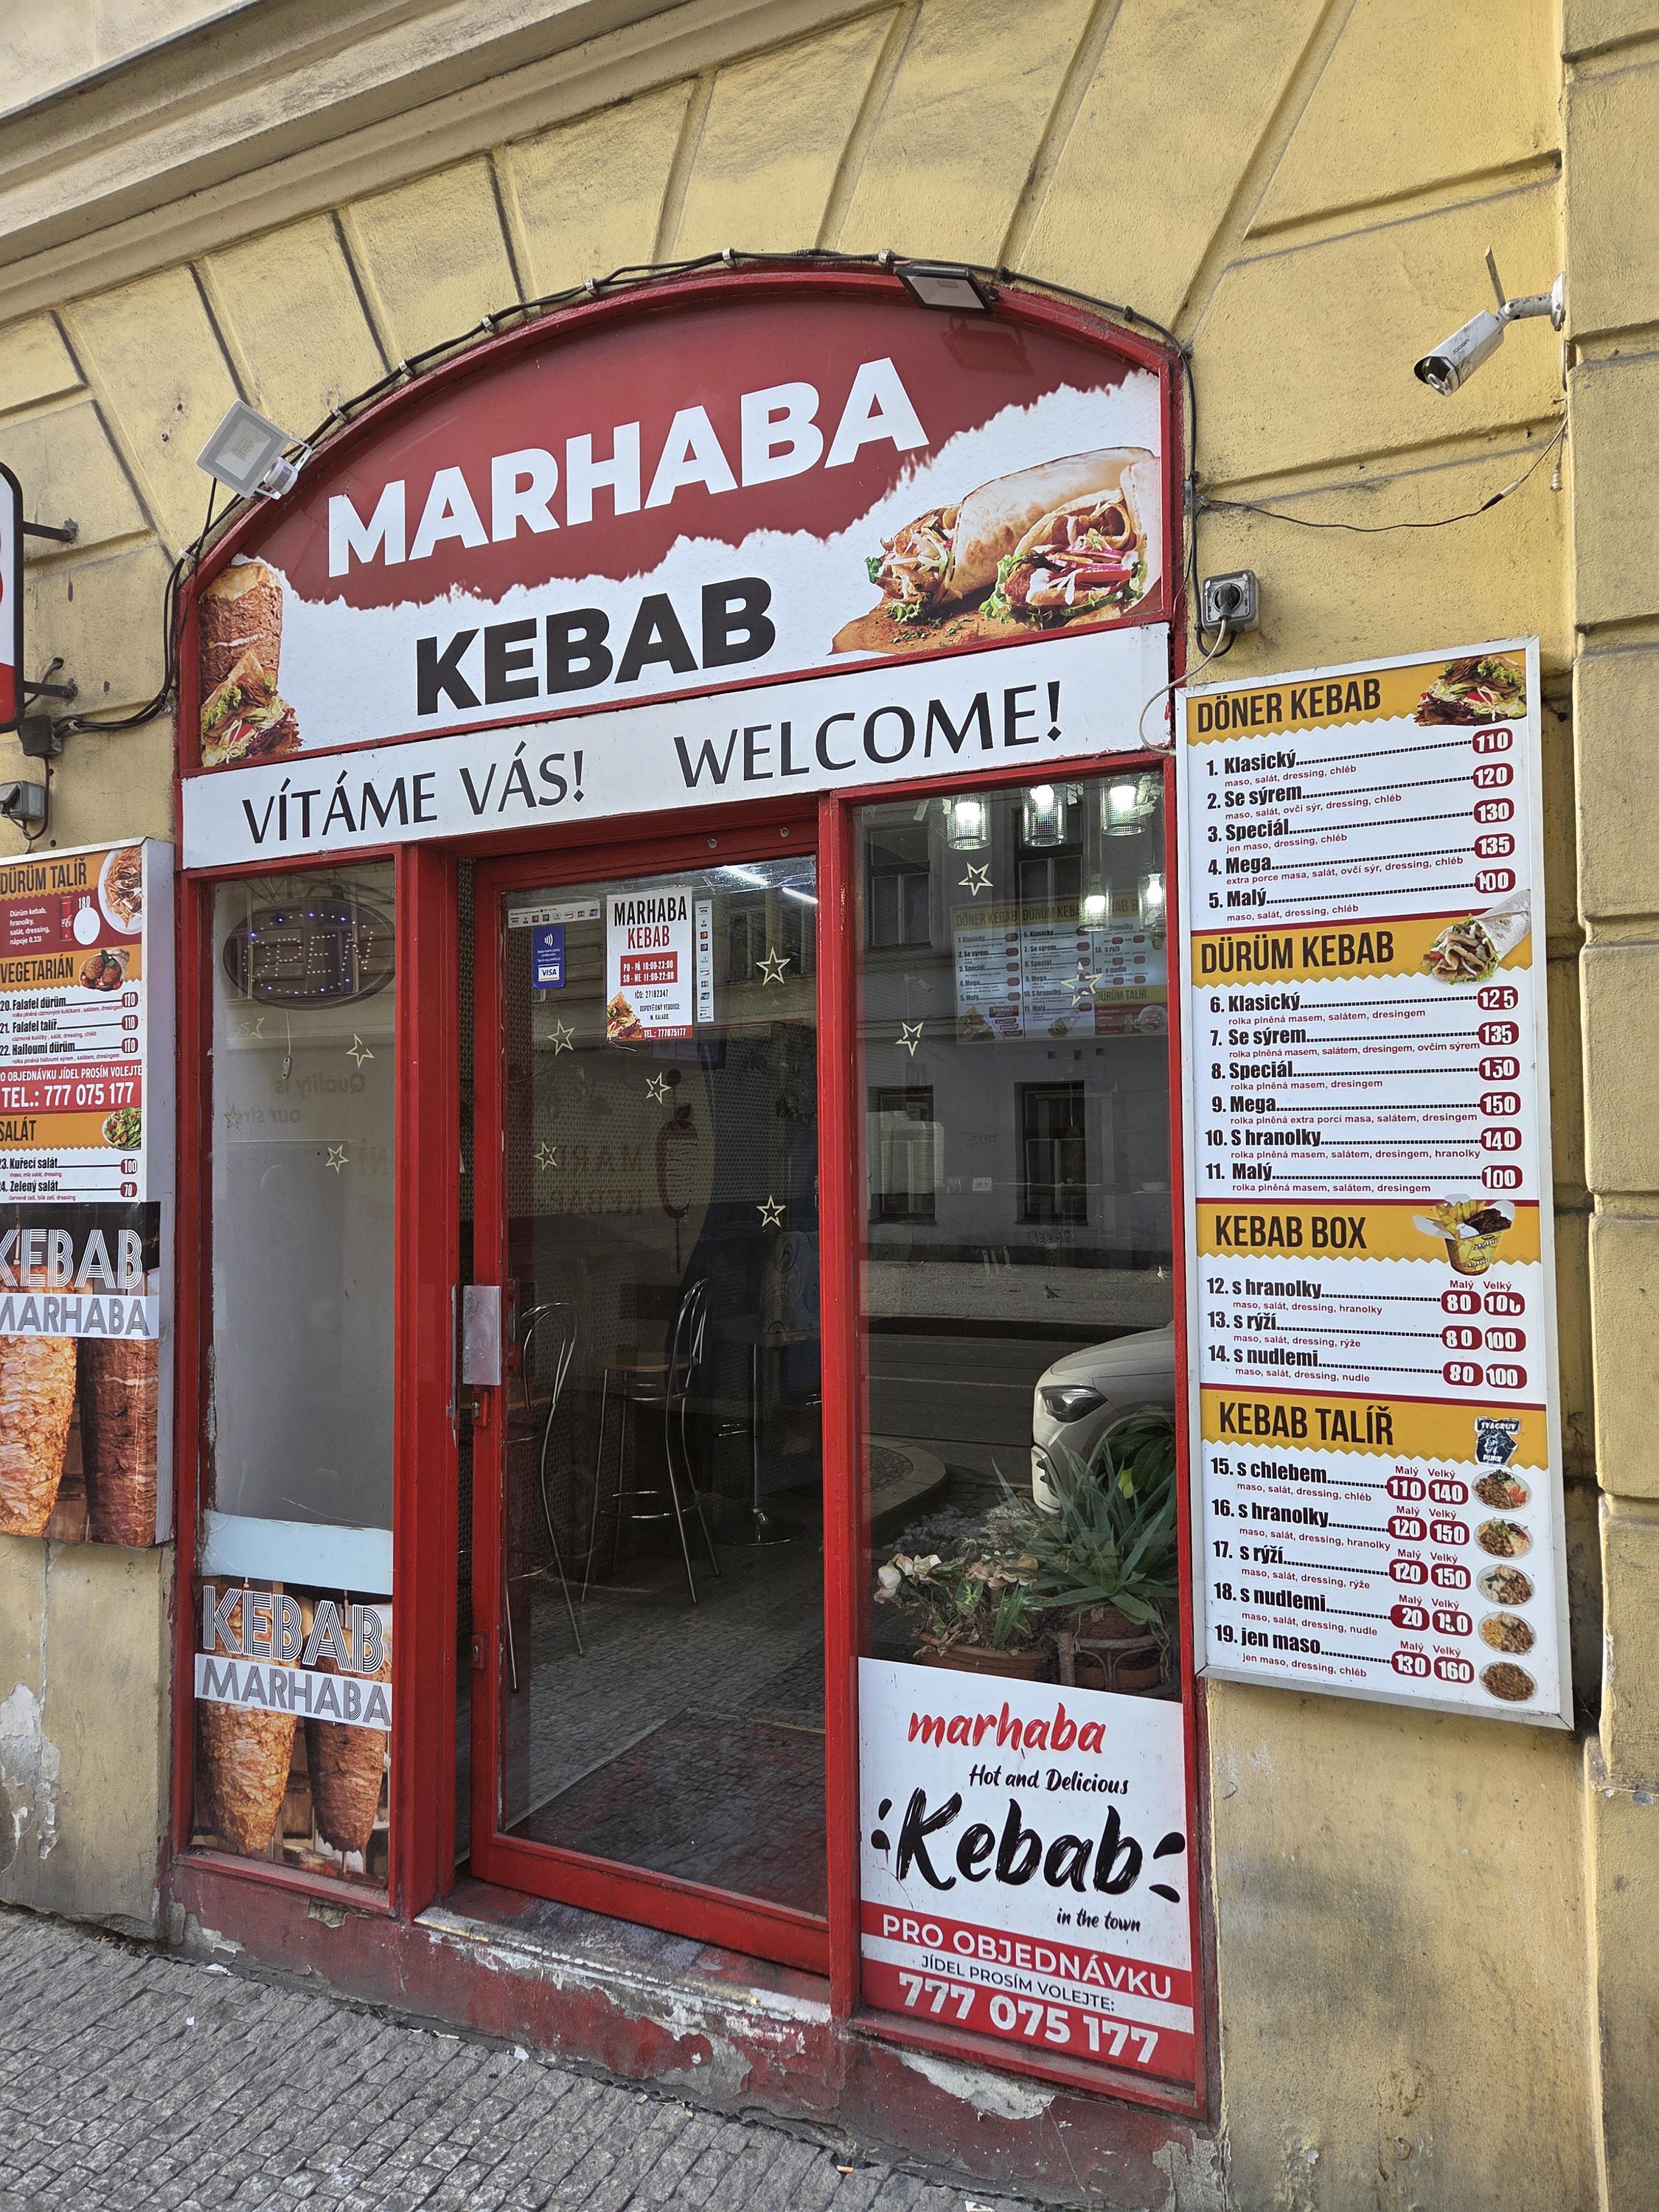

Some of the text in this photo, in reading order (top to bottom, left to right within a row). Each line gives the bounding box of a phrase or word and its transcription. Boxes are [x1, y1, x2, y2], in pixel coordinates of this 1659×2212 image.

[327, 357, 929, 579] MARHABA
[415, 577, 776, 717] KEBAB
[1197, 678, 1380, 733] DÖNER KEBAB
[673, 680, 1063, 789] WELCOME!
[1206, 760, 1218, 776] 1.
[1476, 731, 1509, 751] 110
[1225, 765, 1356, 787] maso, salát, dressing, chléb
[242, 749, 584, 845] VÍTÁME VÁS!
[1208, 859, 1222, 875] 4.
[1478, 837, 1509, 855] 135
[1226, 877, 1249, 885] extra
[1252, 875, 1279, 884] porce
[1312, 868, 1338, 877] salát,
[1340, 866, 1361, 874] ovčí
[1364, 861, 1382, 874] sýr,
[1385, 860, 1429, 871] dressing,
[1436, 856, 1463, 866] chléb
[0, 857, 87, 894] DÜRÜM TALÍŘ
[78, 896, 91, 909] 180
[614, 896, 687, 927] MARHABA
[627, 925, 670, 950] KEBAB
[1201, 931, 1394, 973] DÜRÜM KEBAB
[0, 954, 73, 984] VEGETARIÁN
[541, 968, 557, 976] VISA
[623, 963, 630, 973] PO
[635, 961, 641, 970] PÁ
[623, 974, 630, 983] SO
[634, 973, 641, 982] NE
[0, 1001, 12, 1012] 20.
[13, 998, 39, 1010] Falafel
[125, 993, 135, 1006] 110
[0, 1023, 10, 1033] 21.
[13, 1020, 39, 1033] Falafel
[125, 1016, 135, 1029] 110
[1210, 1030, 1222, 1046] 7.
[1228, 1029, 1249, 1046] Se
[1483, 1023, 1512, 1043] 135
[0, 1046, 10, 1056] 22.
[13, 1042, 47, 1055] Halloumi
[125, 1040, 135, 1052] 110
[1229, 1050, 1251, 1058] rolka
[1253, 1048, 1282, 1059] plněná
[1322, 1046, 1360, 1055] salátem,
[1363, 1045, 1415, 1054] dresingem,
[1417, 1043, 1447, 1051] ovčím
[1450, 1042, 1480, 1051] sýrem
[7, 1068, 57, 1082] OBJEDNÁVKU
[58, 1066, 80, 1079] JÍDEL
[81, 1065, 108, 1079] PROSÍM
[1, 1082, 134, 1107] TEL.: 777 075 177
[0, 1116, 36, 1141] SALÁT
[10, 1157, 36, 1169] Kuřecí
[124, 1160, 137, 1173] 100
[10, 1180, 37, 1194] Zelený
[125, 1183, 132, 1197] 70
[1216, 1215, 1367, 1249] KEBAB BOX
[1450, 1280, 1512, 1292] Malý Velký
[1208, 1345, 1230, 1362] 14.
[1234, 1349, 1243, 1363] s
[1450, 1364, 1474, 1382] 80
[1488, 1366, 1517, 1386] 100
[1235, 1368, 1369, 1382] maso, salát, dressing, nudle
[1220, 1402, 1393, 1445] KEBAB TALÍŘ
[1211, 1499, 1234, 1517] 16.
[1238, 1504, 1248, 1518] s
[1392, 1519, 1422, 1539] 120
[1433, 1524, 1465, 1545] 150
[1397, 1506, 1456, 1520] Malý Velký
[1239, 1528, 1391, 1551] maso, salát, dressing, hranolky
[203, 1585, 384, 1674] KEBAB
[202, 1658, 392, 1727] MARHABA
[908, 1702, 1106, 1754] marhaba
[969, 1764, 1129, 1795] Hot and Delicious
[896, 1786, 1143, 1895] Kebab
[1057, 1907, 1141, 1933] in the town
[883, 1913, 1172, 2000] PRO OBJEDNÁVKU
[921, 1954, 1116, 2012] JÍDEL PROSÍM VOLEJTE:
[900, 1972, 1160, 2064] 777 075 177
